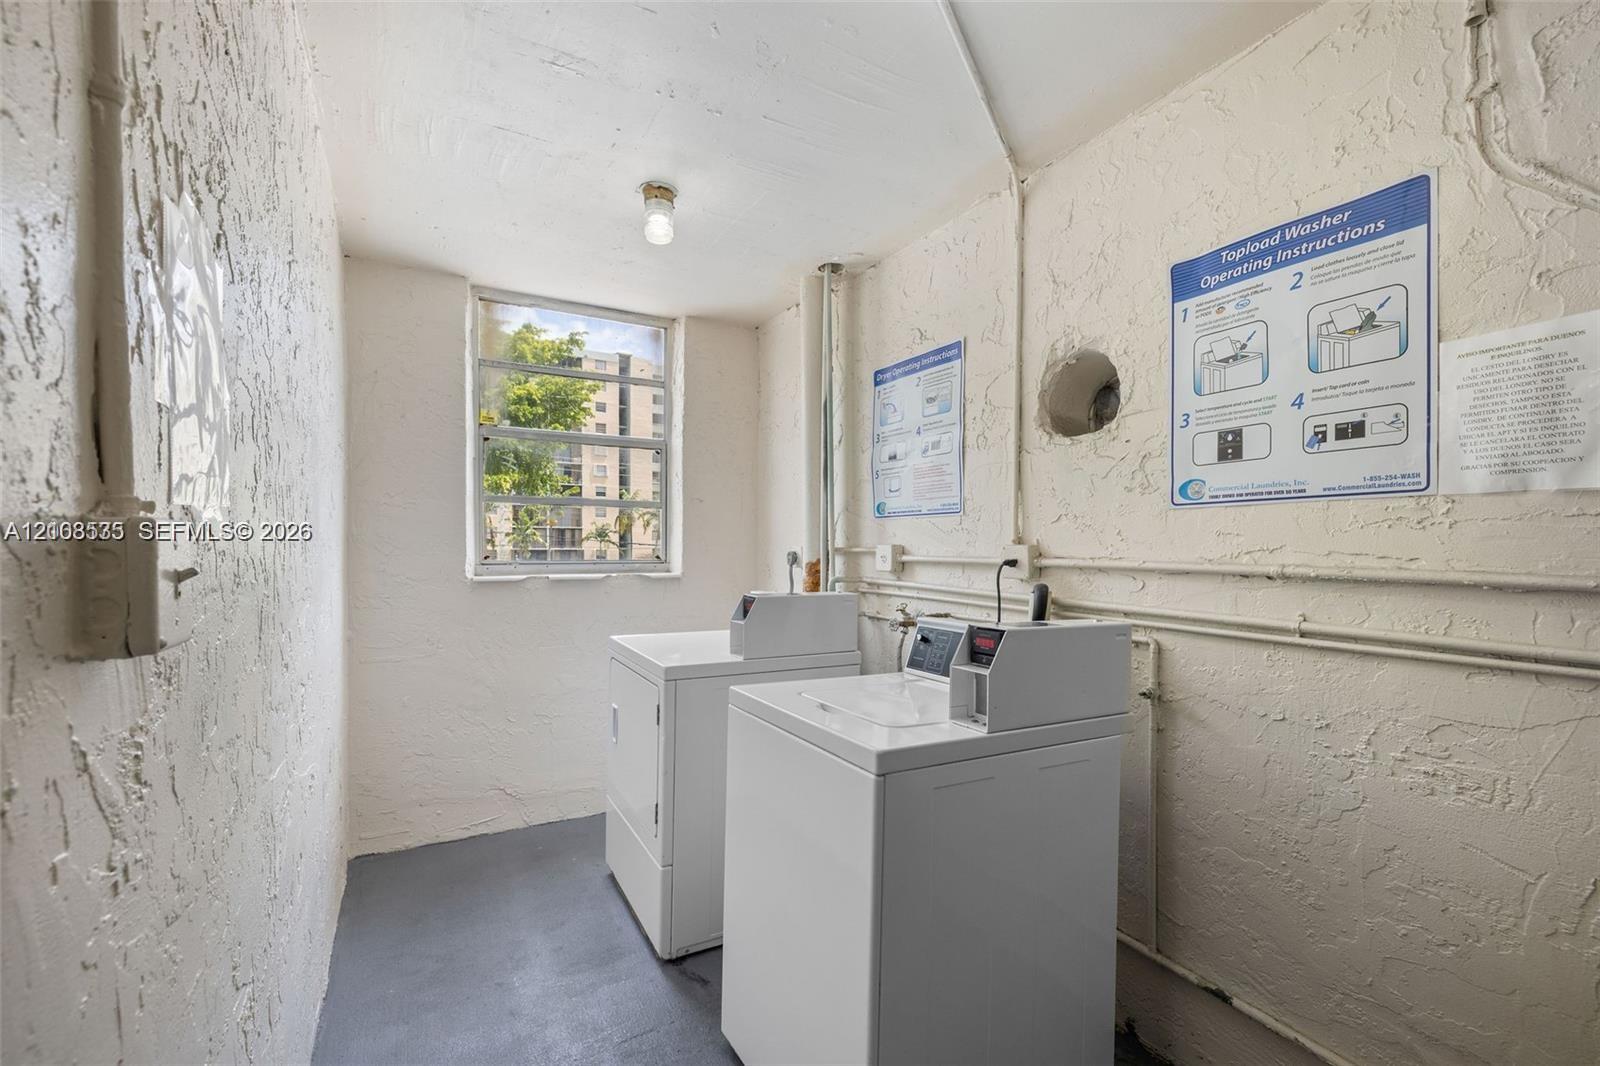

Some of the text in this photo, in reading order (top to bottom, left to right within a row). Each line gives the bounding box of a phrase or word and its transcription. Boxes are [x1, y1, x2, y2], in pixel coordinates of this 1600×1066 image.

[1220, 210, 1352, 264] Topload Washer
[1200, 219, 1385, 289] Operating Instructions
[1325, 259, 1345, 269] clothes
[1346, 252, 1366, 262] loosely
[1367, 247, 1379, 256] and
[1380, 243, 1395, 252] close
[1401, 253, 1416, 262] tapa
[1311, 271, 1331, 280] Coloque
[1390, 250, 1402, 258] que
[1290, 271, 1304, 291] 2
[1181, 307, 1189, 323] 1
[1457, 351, 1478, 359] AVISO
[1478, 341, 1527, 354] IMPORTANTE
[1528, 337, 1549, 346] PARA
[876, 369, 892, 382] Dryer
[892, 359, 921, 379] Operating
[921, 348, 958, 366] Instructions
[1462, 357, 1580, 381] UNICAMENTE PARA DESECHAR
[1480, 362, 1505, 372] CESTO
[1506, 359, 1520, 367] DEL
[1522, 353, 1556, 364] LONDRY
[916, 377, 921, 387] 2
[1456, 380, 1491, 390] RESIDUOS
[1492, 369, 1554, 384] RELACIONADOS
[1556, 366, 1574, 374] CON
[1291, 393, 1304, 410] 4
[1473, 392, 1509, 402] PERMITEN
[1511, 388, 1533, 396] OTRO
[1535, 385, 1554, 393] TIPO
[1511, 394, 1550, 404] TAMPOCO
[1551, 391, 1572, 399] ESTA
[1460, 409, 1499, 418] PERMITIDO
[1501, 404, 1528, 412] FUMAR
[1530, 400, 1565, 409] DENTRO
[1509, 408, 1557, 420] CONTINUAR
[1180, 413, 1190, 429] 3
[1466, 423, 1505, 432] CONDUCTA
[1518, 416, 1567, 426] PROCEDERA
[1541, 421, 1586, 432] INQUILINO
[876, 434, 880, 443] 3
[916, 426, 921, 436] 4
[1480, 436, 1525, 446] CANCELARA
[1539, 430, 1586, 440] CONTRATO
[1490, 444, 1521, 453] DUENOS
[1534, 440, 1557, 448] CASO
[1522, 456, 1577, 466] COOPEACION
[875, 470, 879, 479] 5
[1363, 472, 1420, 482] 1-855-254-WASH
[1208, 483, 1249, 493] Commercial
[1252, 480, 1291, 489] Laundries,
[1323, 480, 1422, 492] www.CommercialLaundries.com
